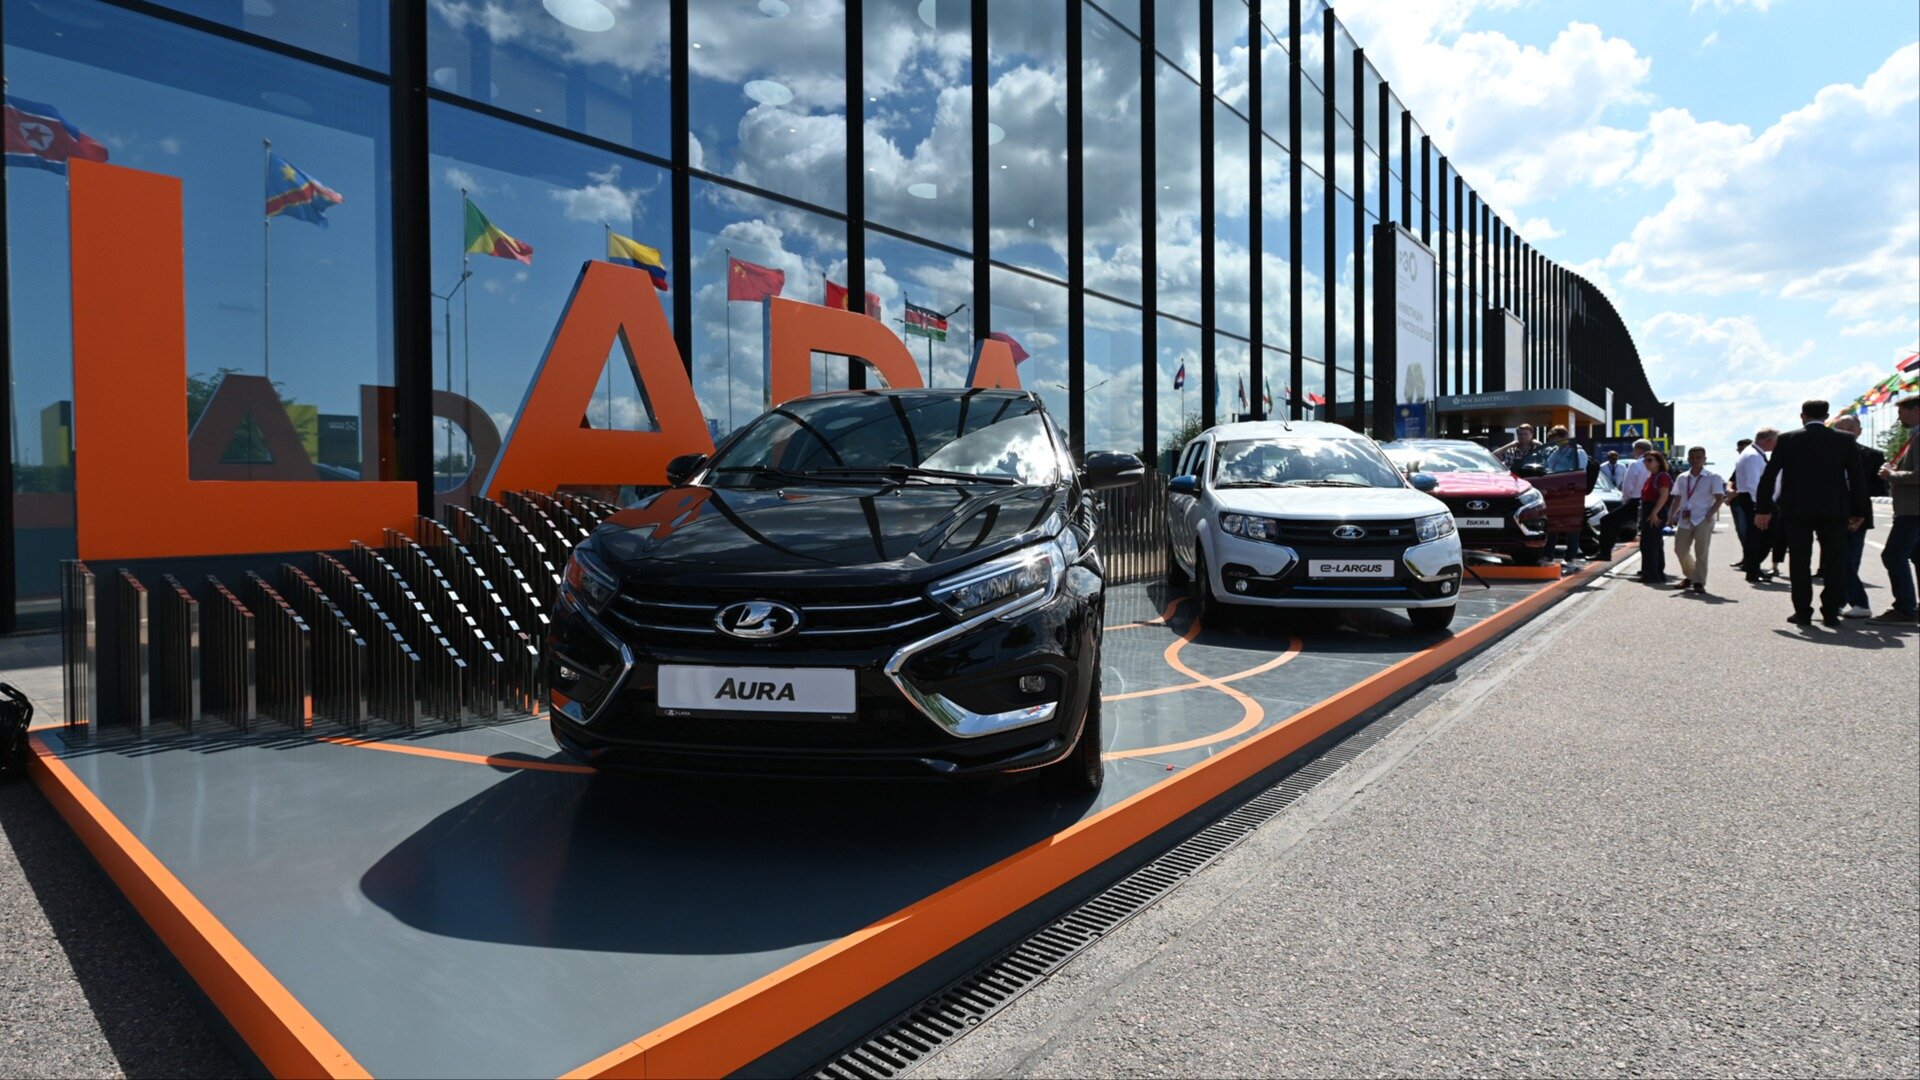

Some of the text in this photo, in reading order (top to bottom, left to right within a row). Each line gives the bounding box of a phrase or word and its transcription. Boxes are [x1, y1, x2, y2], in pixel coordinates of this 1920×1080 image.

[69, 158, 1022, 560] LAD
[1320, 564, 1382, 573] e-LARGUS
[714, 677, 796, 701] AURA
